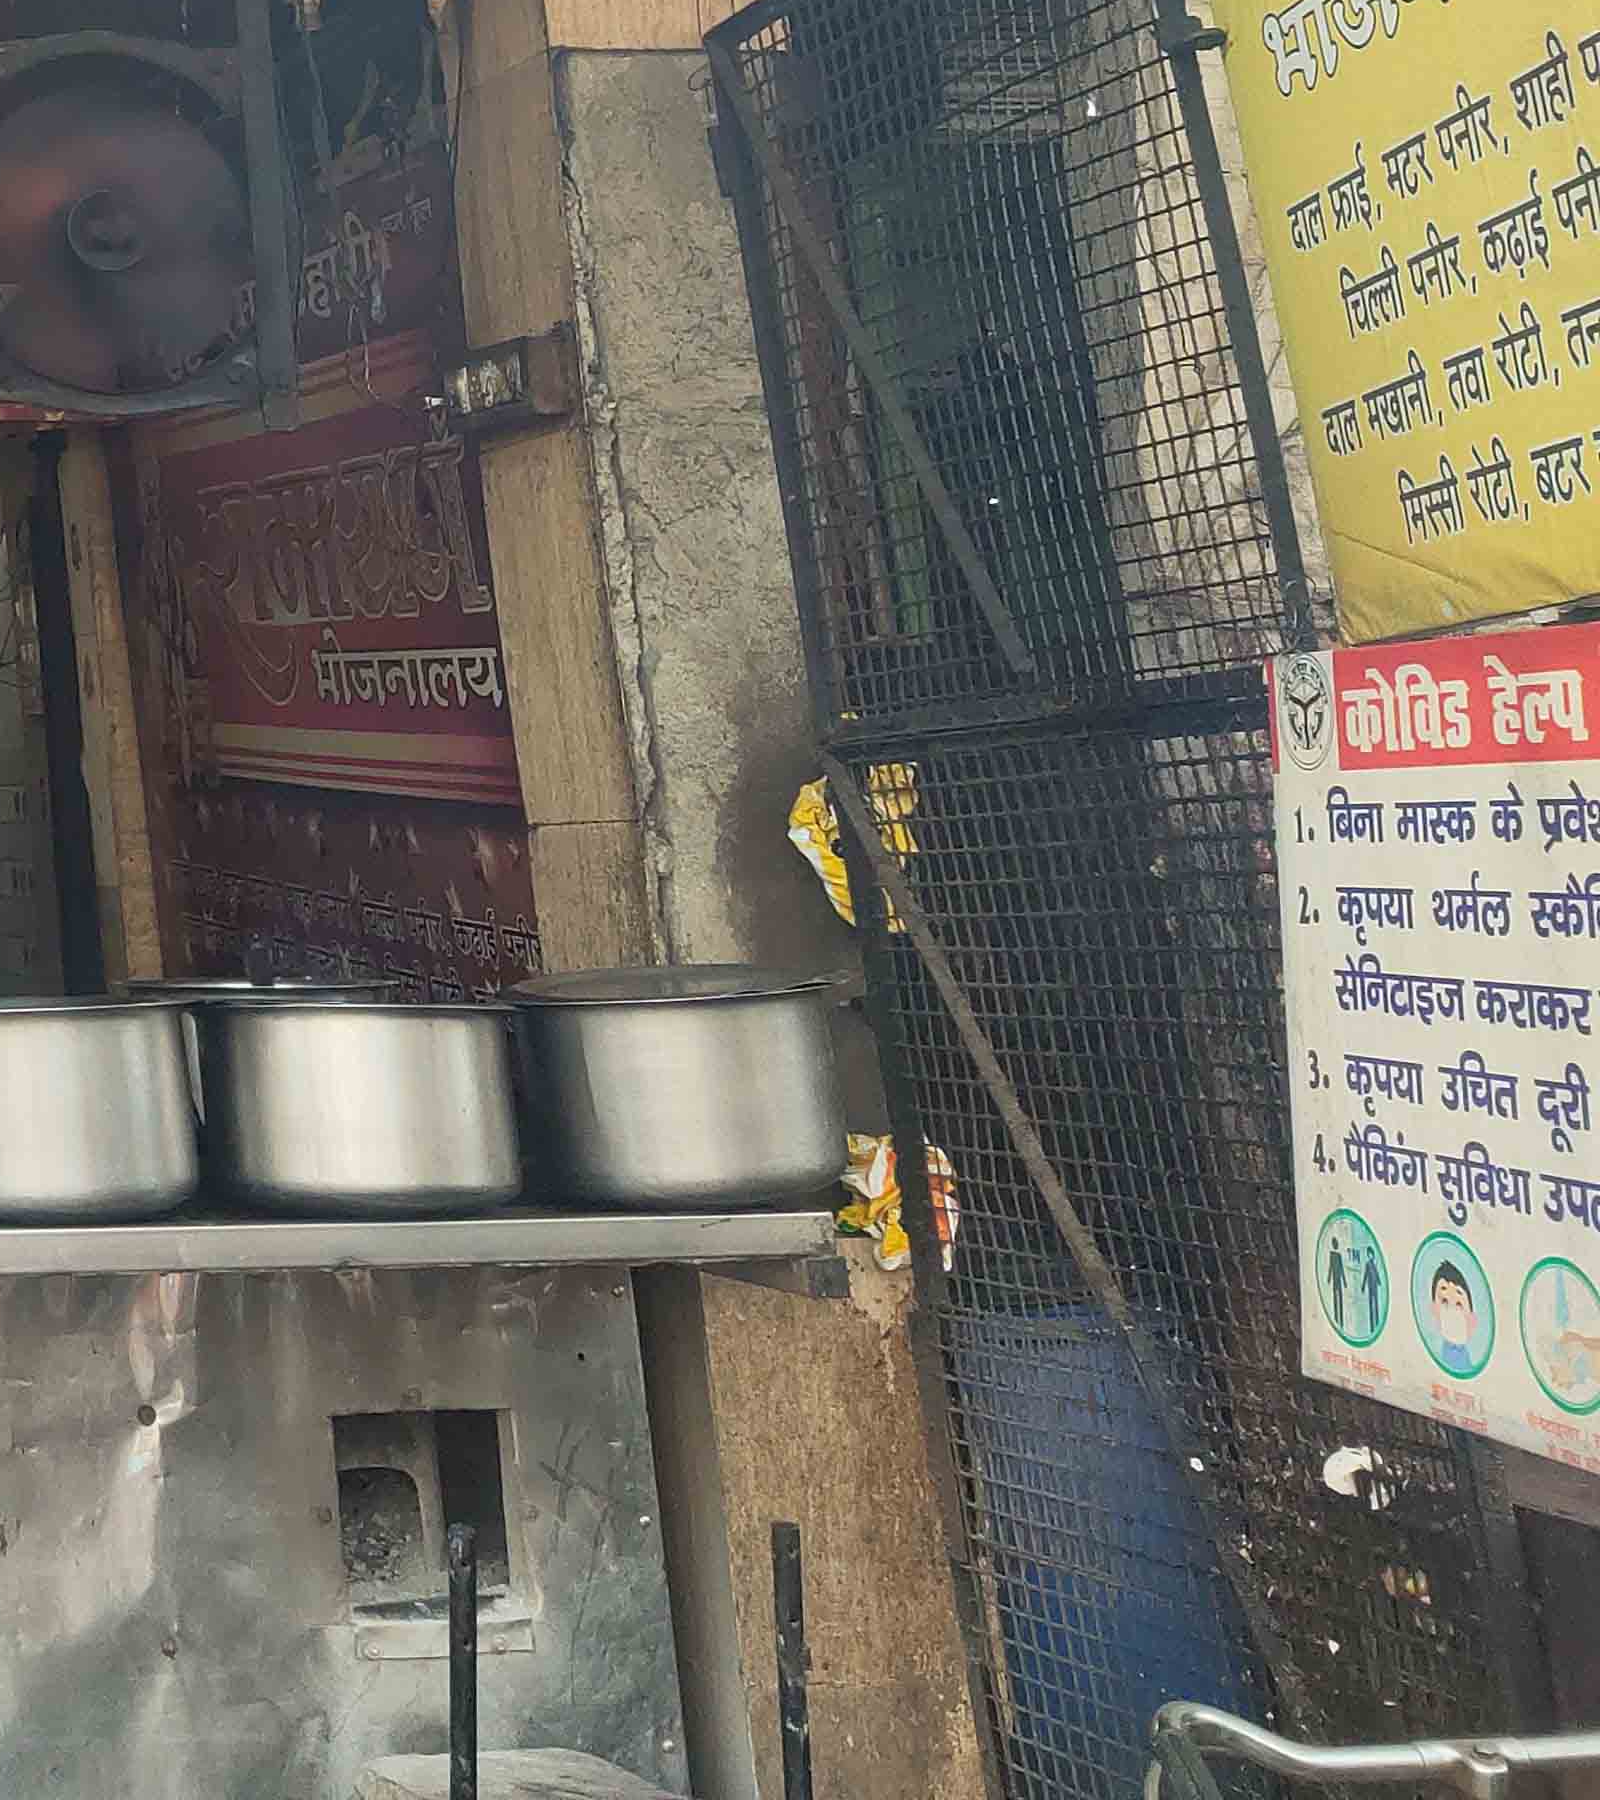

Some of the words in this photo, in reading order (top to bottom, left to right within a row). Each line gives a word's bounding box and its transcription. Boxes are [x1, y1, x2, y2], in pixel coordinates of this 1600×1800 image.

[1286, 191, 1328, 251] दाल
[1381, 131, 1434, 199] मटर
[1509, 31, 1577, 131] शाही
[1340, 245, 1407, 340] चिल्ली
[1477, 168, 1550, 281] कढ़ाई
[1321, 399, 1364, 457] दाल
[1442, 347, 1491, 412] तवा
[1398, 453, 1465, 545] मिस्सी
[1529, 435, 1592, 504] बटर
[311, 628, 506, 710] भोजनालय
[1341, 663, 1472, 753] कोविड
[1482, 655, 1590, 745] हेल्प
[1327, 785, 1385, 844] बिना
[1395, 799, 1476, 844] मास्क
[1488, 781, 1525, 843] के
[1336, 886, 1415, 946] कृपया
[1432, 870, 1512, 937] थर्मल
[1334, 953, 1465, 1027] सेनिटाइज
[1473, 979, 1593, 1036] कराकर
[1343, 1054, 1424, 1118] कृपया
[1437, 1050, 1519, 1121] उचित
[1534, 1061, 1591, 1154] दूरी
[1343, 1121, 1429, 1194] पैकिंग
[1434, 1141, 1533, 1227] सुविधा
